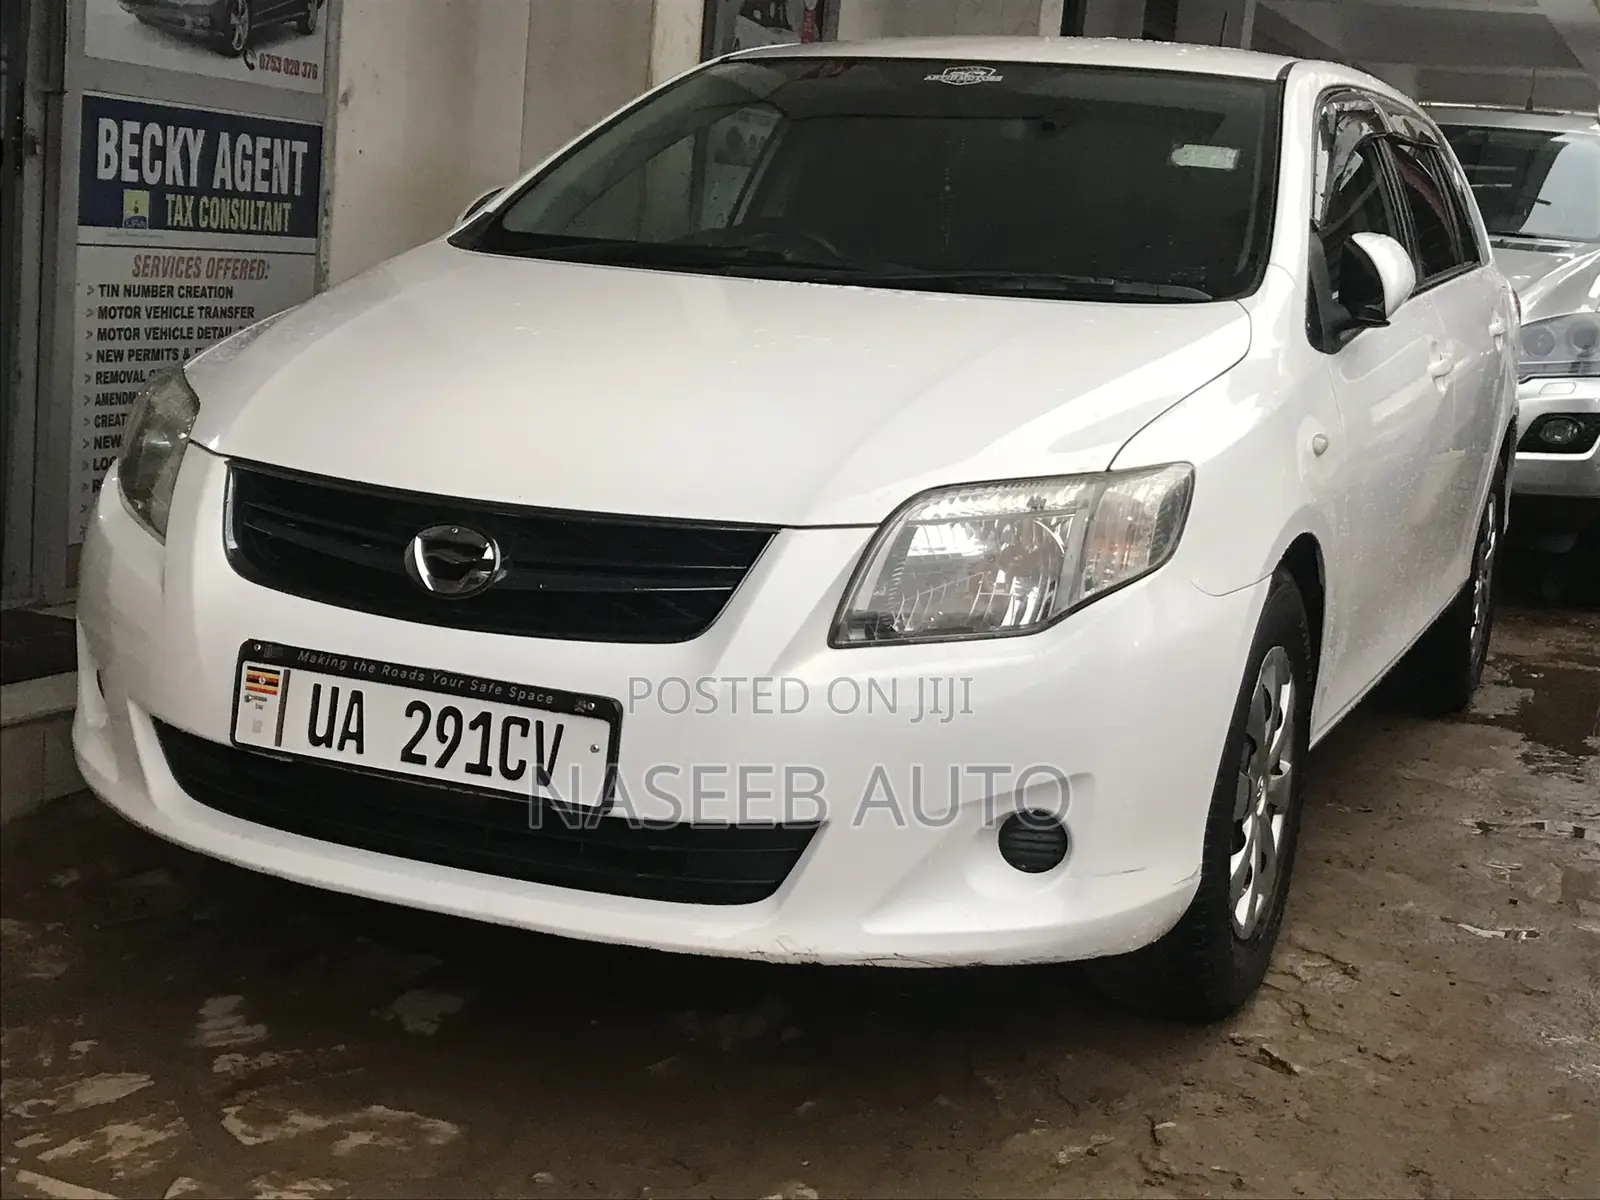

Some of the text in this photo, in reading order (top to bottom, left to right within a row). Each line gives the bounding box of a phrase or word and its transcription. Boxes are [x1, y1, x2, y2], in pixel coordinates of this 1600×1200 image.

[259, 53, 282, 73] 0753
[97, 117, 308, 196] BECKY AGENT
[165, 193, 292, 232] TAX CONSULTANT
[132, 254, 270, 280] SERVICES OFFERED:
[98, 284, 233, 299] TIN NUMBER CREATION
[97, 305, 255, 319] MOTOR VEHICLE TRANSFER
[97, 327, 140, 341] MOTOR
[145, 326, 193, 340] VEHICLE
[96, 348, 124, 363] NEW
[127, 347, 180, 362] PERMITS
[95, 370, 146, 385] REMOVAL
[93, 434, 122, 449] NEW
[297, 650, 554, 704] Making the Roads Your Safe Space
[307, 683, 564, 787] UA 291CV
